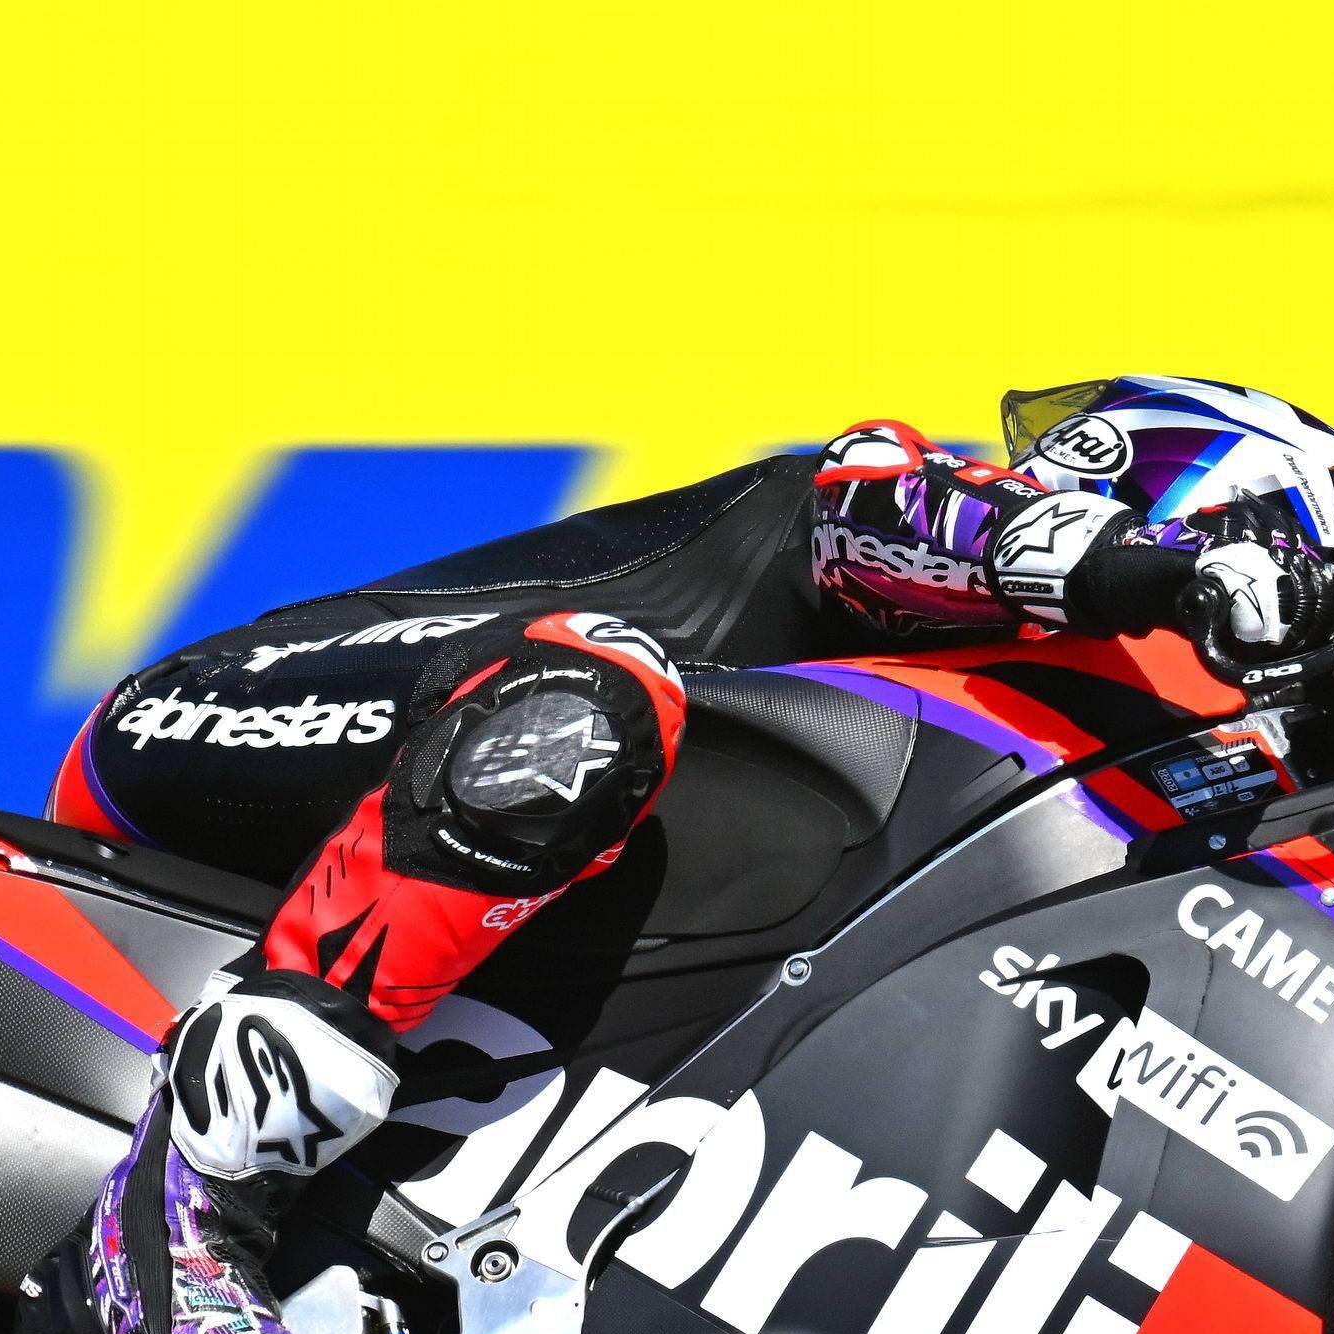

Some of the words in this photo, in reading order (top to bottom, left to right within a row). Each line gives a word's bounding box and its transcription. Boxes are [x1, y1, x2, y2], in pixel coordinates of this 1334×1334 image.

[117, 685, 396, 753] alpinestars
[978, 945, 1105, 1050] sky
[1114, 1037, 1238, 1127] wifi
